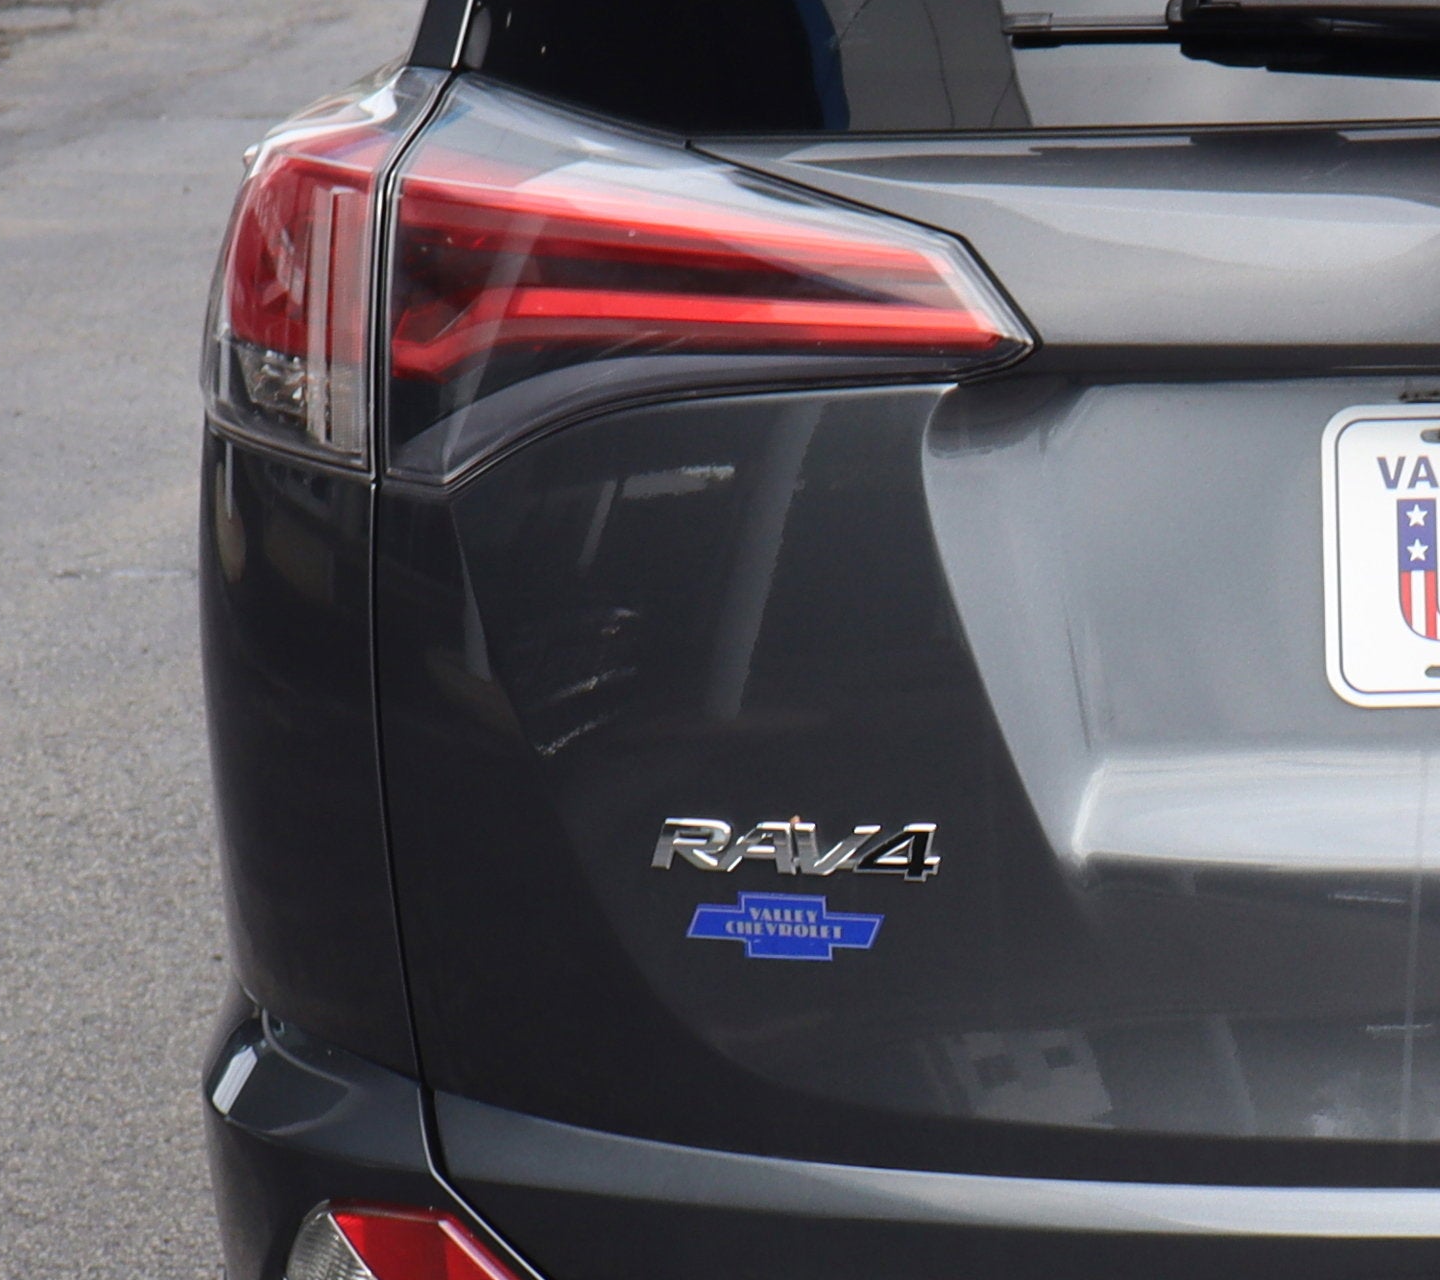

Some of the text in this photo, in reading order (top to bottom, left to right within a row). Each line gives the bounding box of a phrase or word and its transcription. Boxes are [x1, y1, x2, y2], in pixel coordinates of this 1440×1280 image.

[651, 817, 941, 882] RAV4
[749, 907, 818, 924] VALLEY
[725, 920, 842, 939] CHEVROLET
